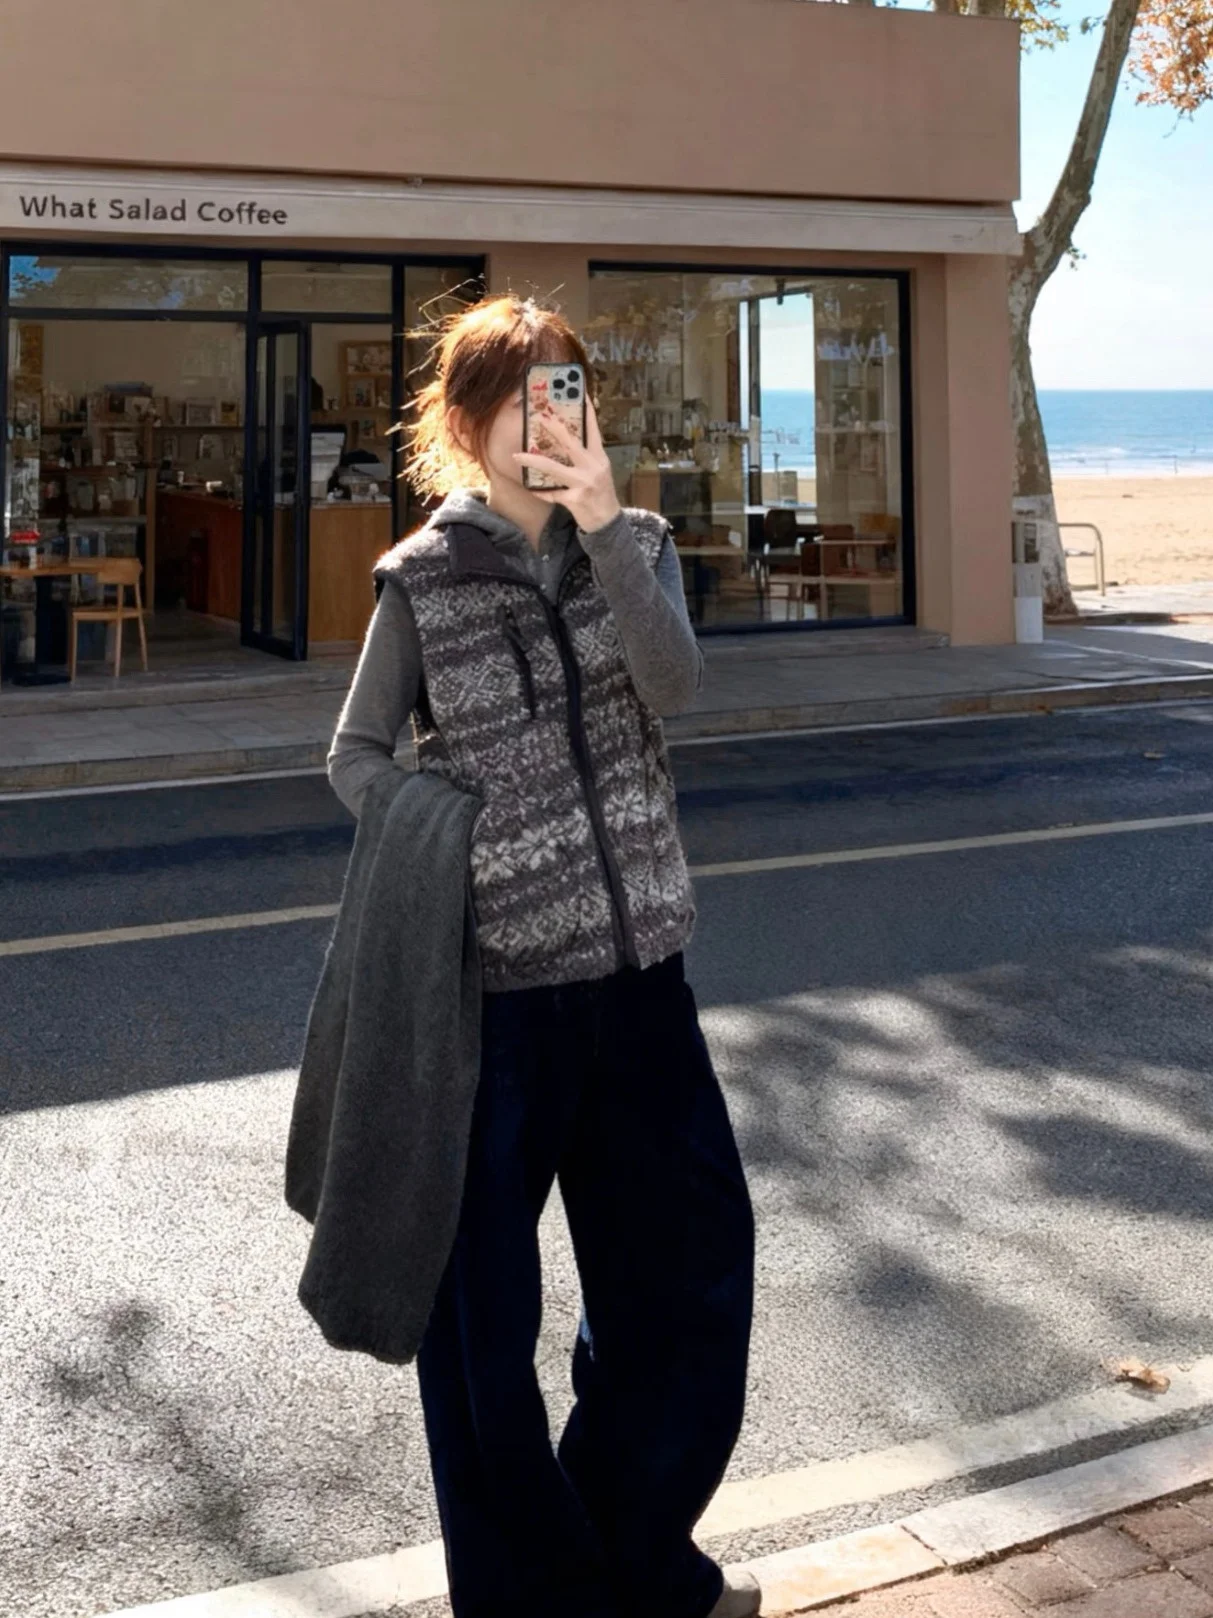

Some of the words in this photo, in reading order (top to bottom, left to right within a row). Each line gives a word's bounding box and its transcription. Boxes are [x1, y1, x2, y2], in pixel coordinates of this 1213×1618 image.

[20, 195, 97, 219] What
[109, 198, 187, 221] Salad
[197, 201, 288, 225] Coffee
